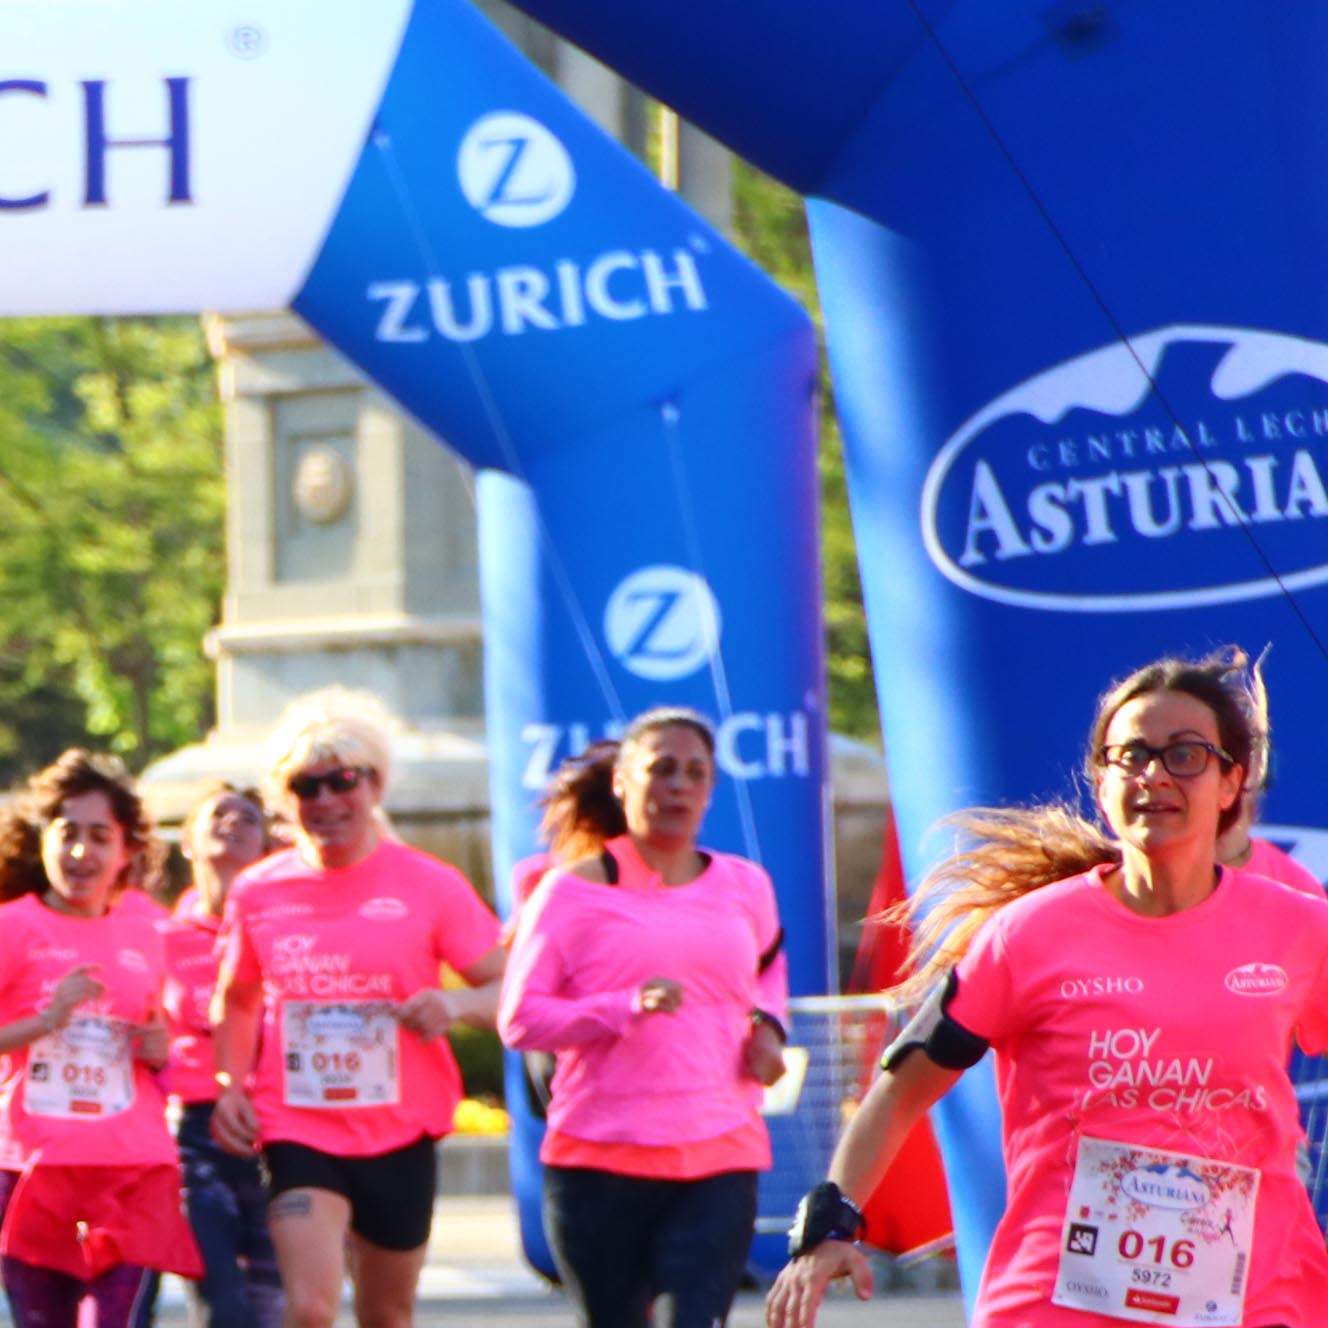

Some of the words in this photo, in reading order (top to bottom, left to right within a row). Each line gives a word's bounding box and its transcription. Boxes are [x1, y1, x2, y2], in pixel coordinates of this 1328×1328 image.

[366, 248, 709, 343] ZURICH
[1027, 420, 1216, 470] CENTRAL
[1060, 976, 1144, 999] OYSHO
[1088, 1027, 1162, 1060] HOY
[311, 1052, 362, 1072] 016
[1088, 1058, 1214, 1089] GANAN
[1147, 1084, 1269, 1113] CHICAS
[1118, 1230, 1197, 1269] 016
[1131, 1268, 1172, 1287] 5972
